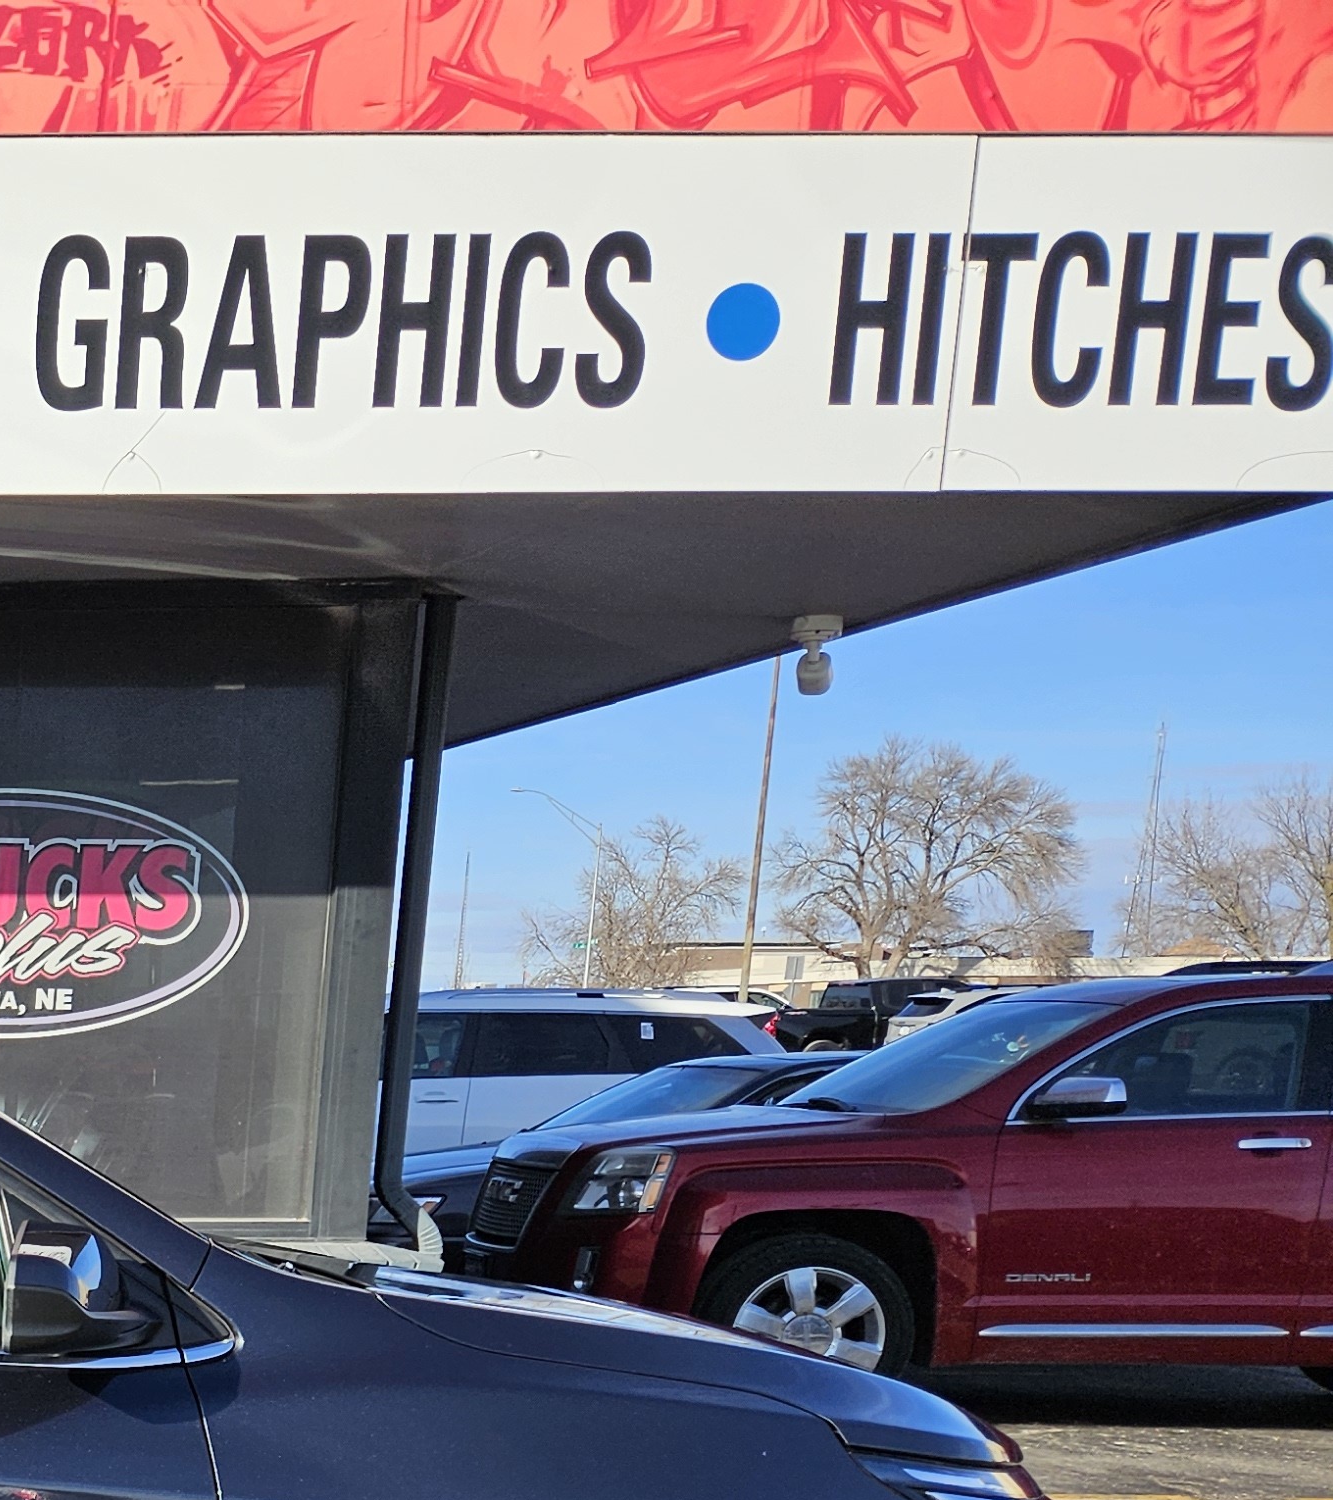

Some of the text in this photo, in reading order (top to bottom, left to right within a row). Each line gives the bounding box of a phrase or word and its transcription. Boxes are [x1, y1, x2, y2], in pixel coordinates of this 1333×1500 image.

[35, 230, 652, 412] GRAPHICS
[828, 230, 1333, 412] HITCHES
[34, 987, 73, 1012] NE
[1004, 1272, 1092, 1283] DENALI
